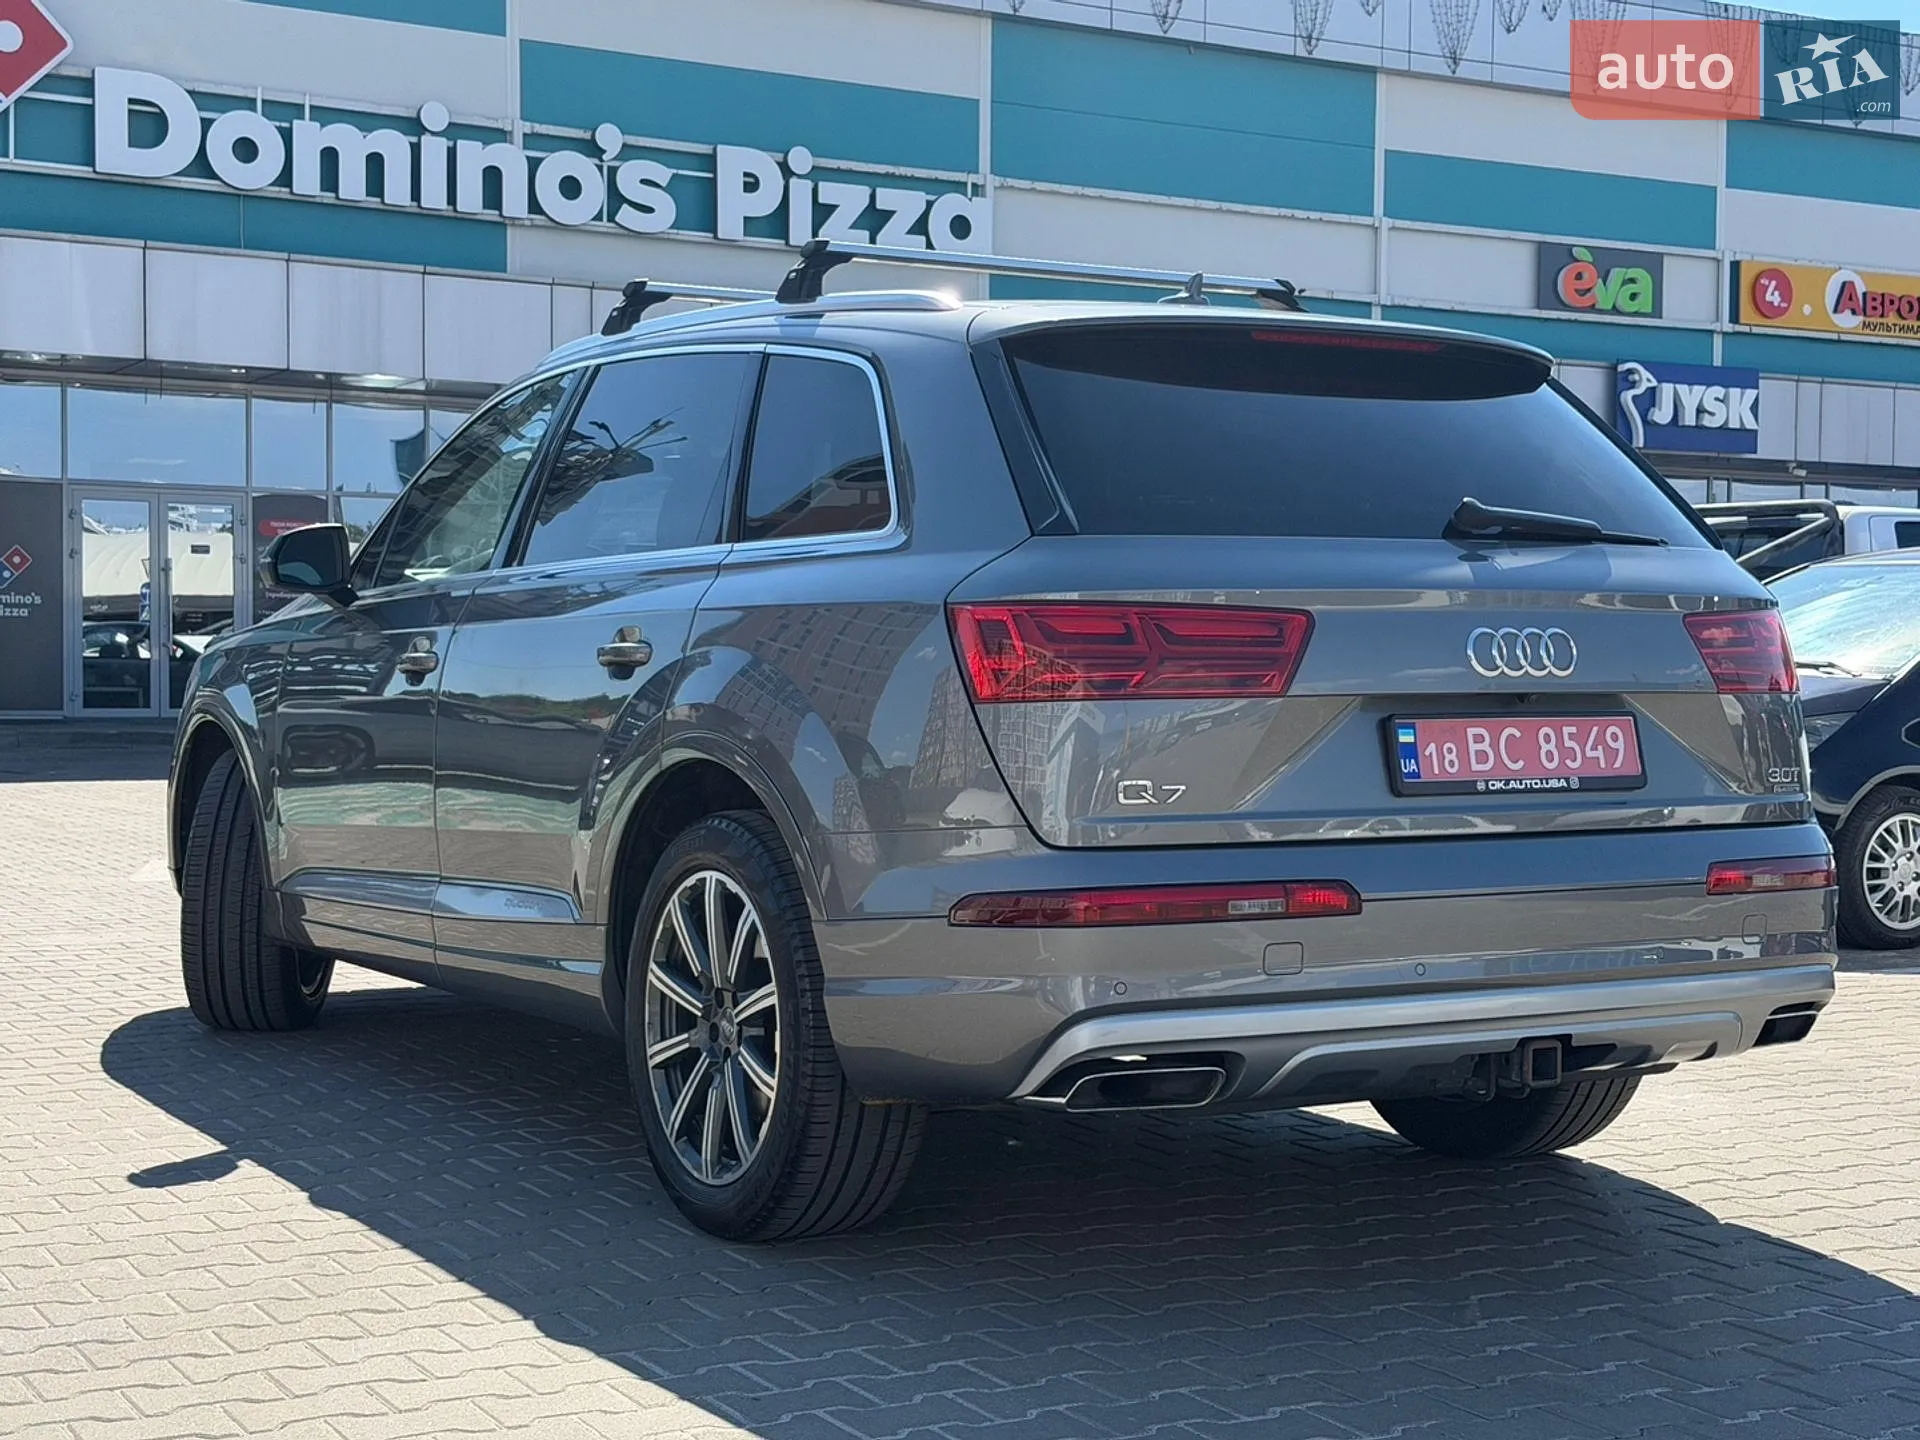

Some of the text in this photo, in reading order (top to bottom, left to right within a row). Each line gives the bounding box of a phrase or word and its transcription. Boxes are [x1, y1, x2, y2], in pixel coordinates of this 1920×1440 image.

[93, 67, 993, 254] Domino's Pizza
[1648, 383, 1759, 430] JYSK
[1401, 758, 1419, 773] UA
[1424, 725, 1625, 774] 18 BC 8549
[1117, 780, 1187, 805] Q7
